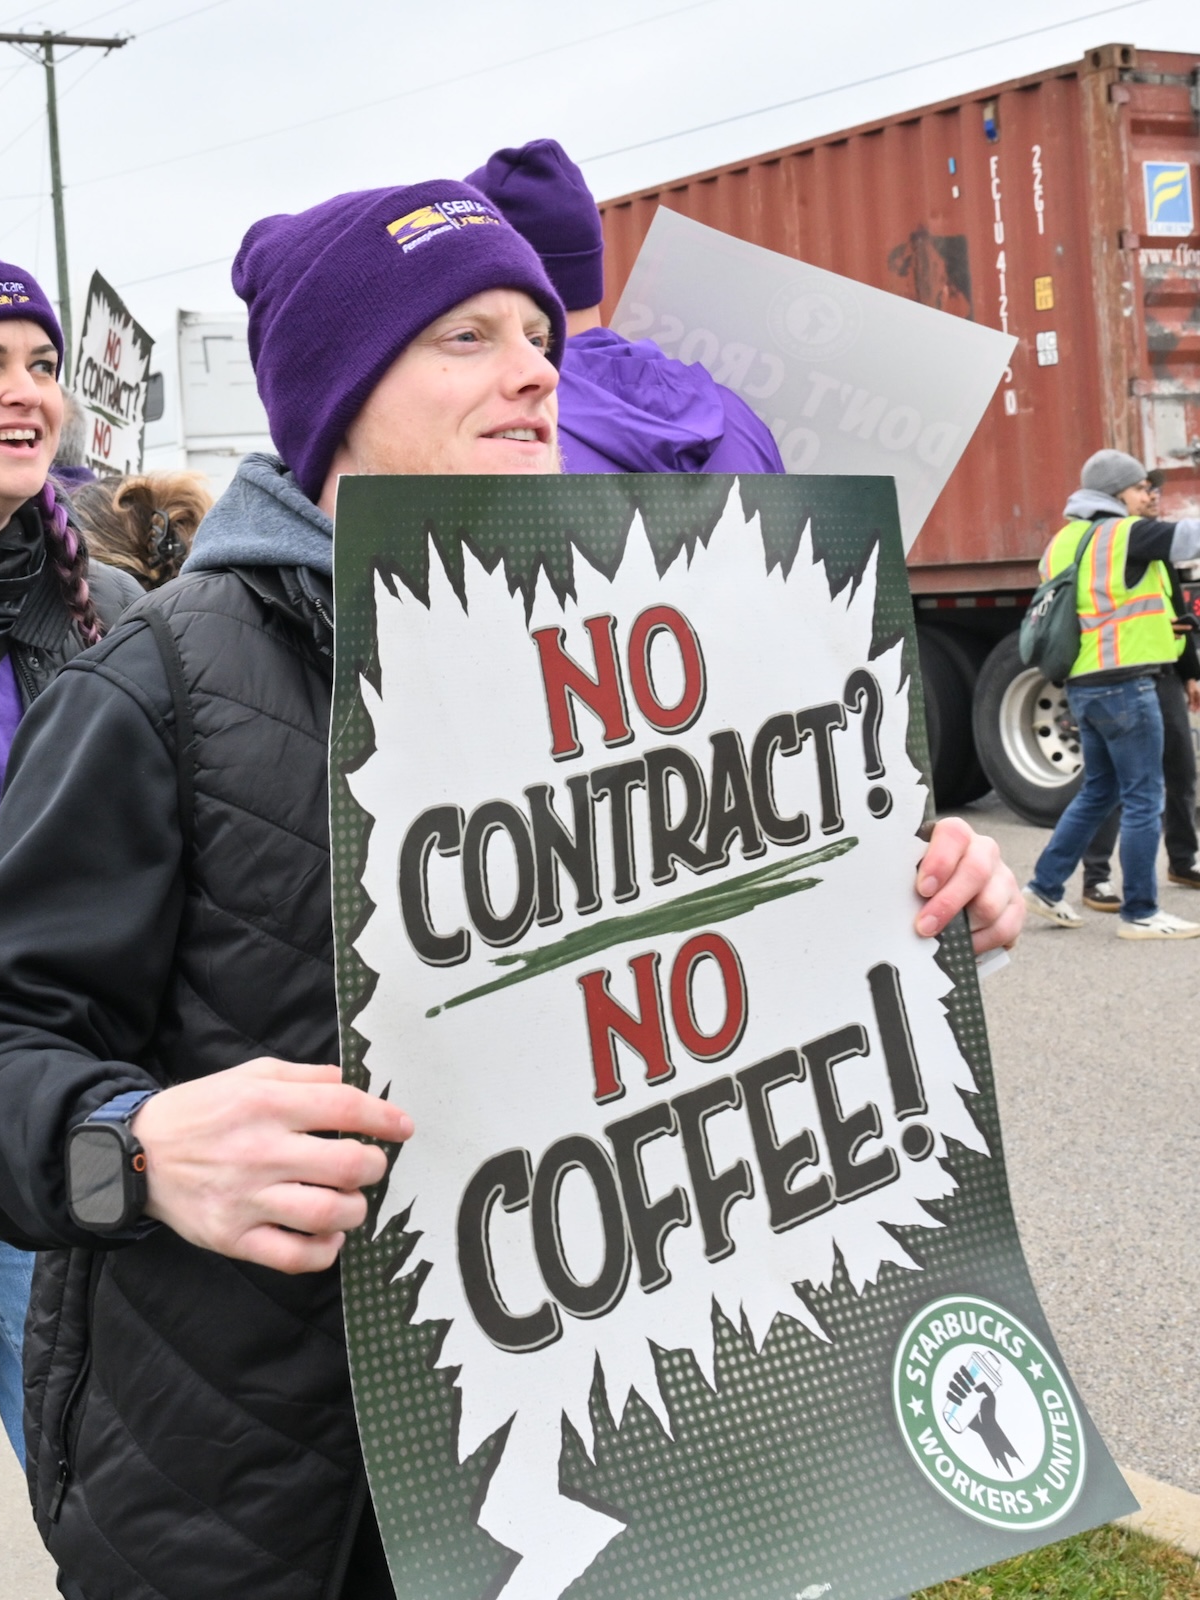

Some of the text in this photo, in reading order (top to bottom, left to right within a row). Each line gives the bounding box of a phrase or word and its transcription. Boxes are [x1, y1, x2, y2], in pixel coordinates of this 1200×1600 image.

[82, 356, 142, 423] CONTRACT?
[103, 328, 122, 372] NO
[92, 417, 113, 459] NO
[531, 602, 709, 761] NO
[398, 668, 893, 969] CONTRACT?
[578, 930, 748, 1104] NO
[456, 960, 936, 1354] COFFEE!
[905, 1310, 1027, 1388] STARBUCKS
[917, 1426, 1034, 1515] WORKERS
[1042, 1389, 1073, 1491] UNITED
